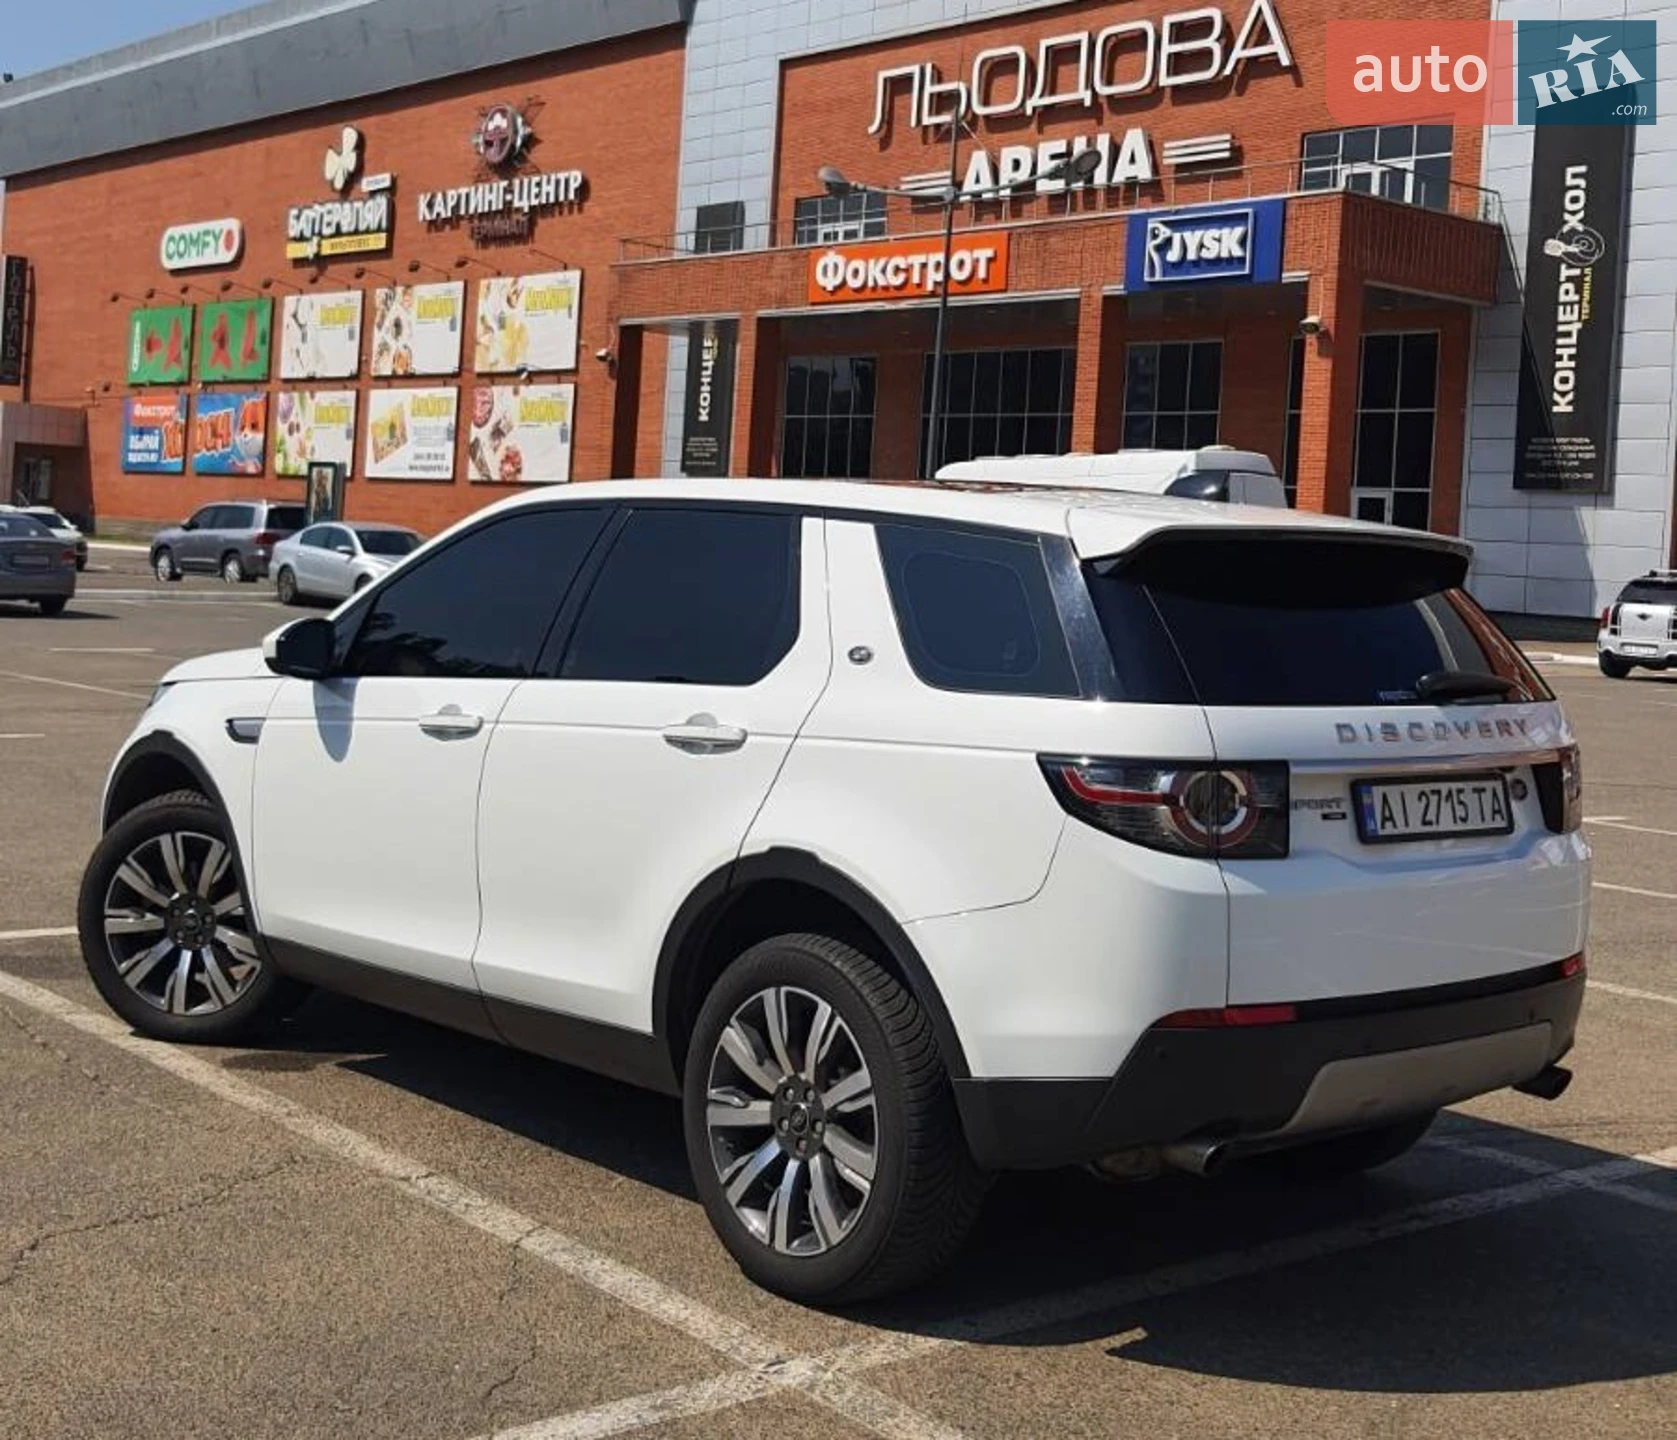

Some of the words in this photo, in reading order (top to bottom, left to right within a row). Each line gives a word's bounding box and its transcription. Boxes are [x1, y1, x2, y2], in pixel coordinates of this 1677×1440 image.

[867, 0, 1292, 135] ЛЬОДОВА
[959, 127, 1153, 203] АРЕНА
[418, 170, 583, 223] КАРТИНГ-ЦЕНТР
[1562, 164, 1588, 234] ХОЛ
[165, 228, 223, 261] COMFY
[1165, 226, 1247, 263] JYSK
[815, 250, 996, 293] Фокстрот
[1551, 264, 1583, 414] КОНЦЕРТ
[1334, 718, 1528, 745] DISCOVERY
[1380, 791, 1410, 830] AI
[1417, 786, 1469, 827] 2715
[1472, 785, 1506, 823] TA
